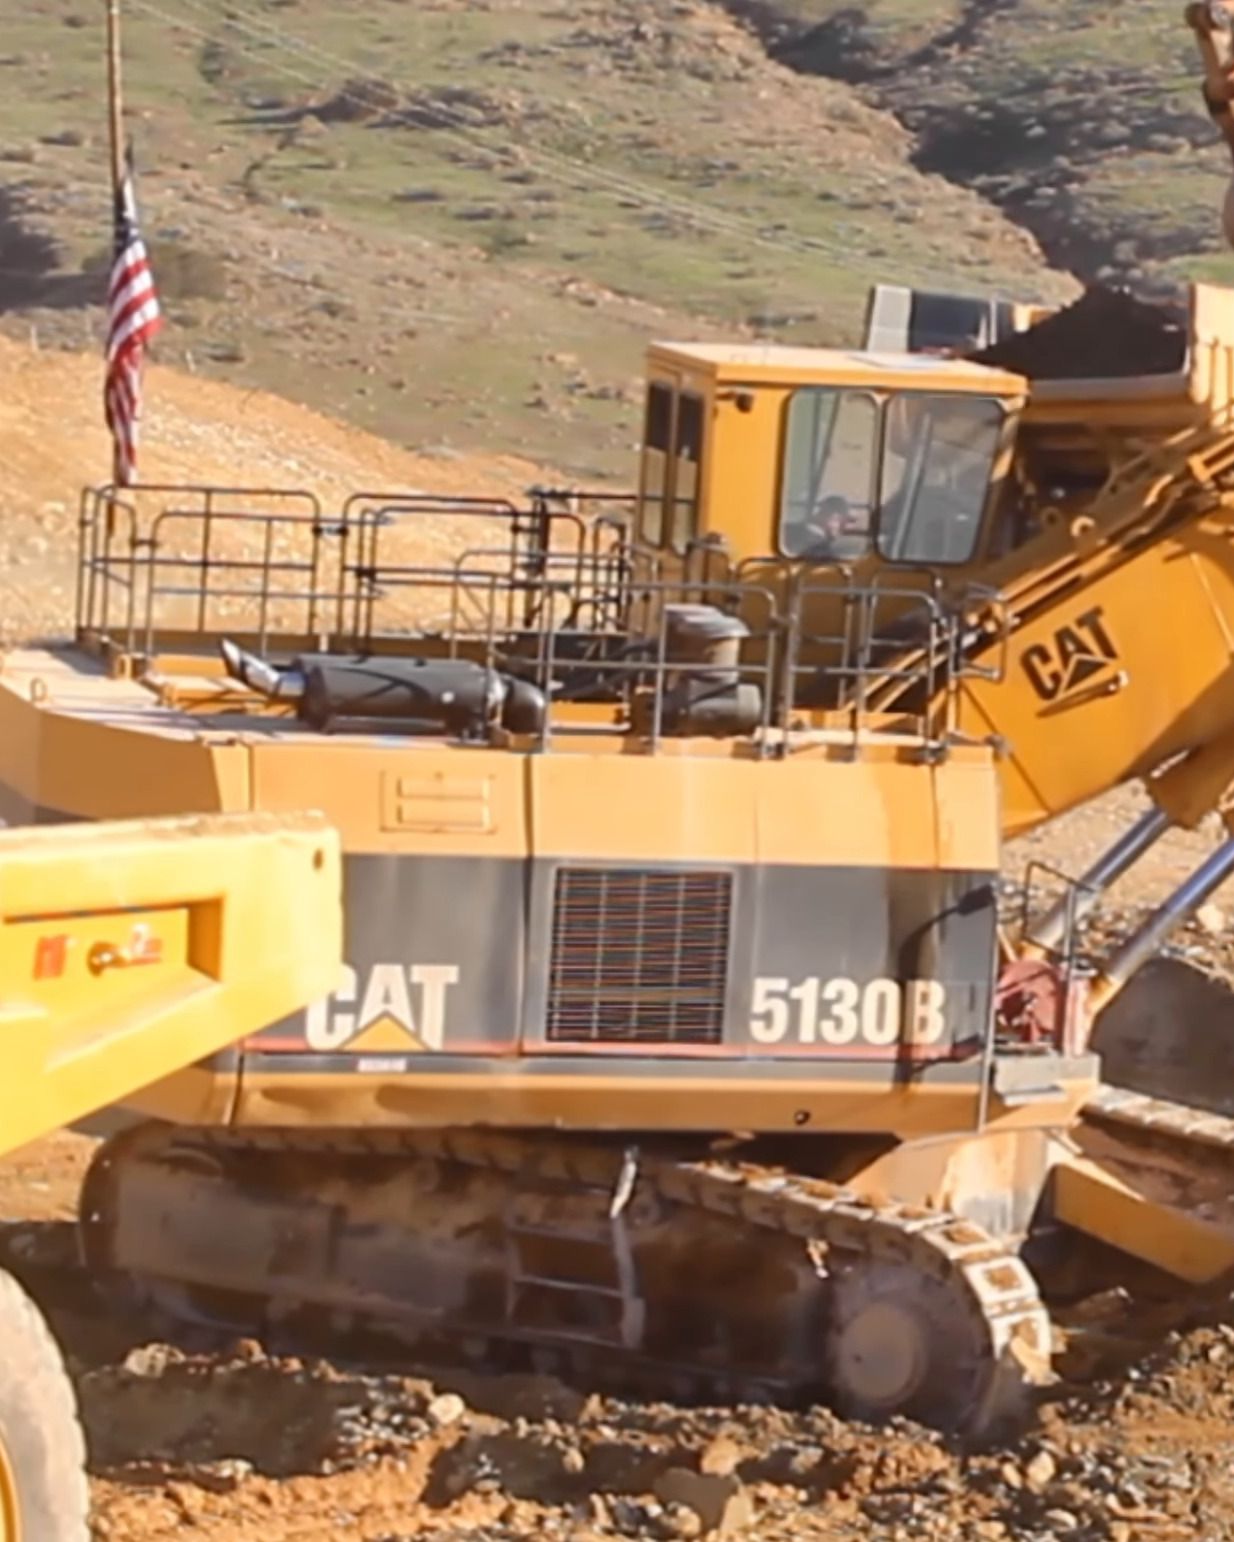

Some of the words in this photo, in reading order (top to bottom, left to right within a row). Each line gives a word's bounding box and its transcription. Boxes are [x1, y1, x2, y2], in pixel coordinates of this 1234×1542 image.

[1020, 606, 1118, 700] CAT
[306, 964, 459, 1051] CAT
[750, 976, 945, 1046] 5130B
